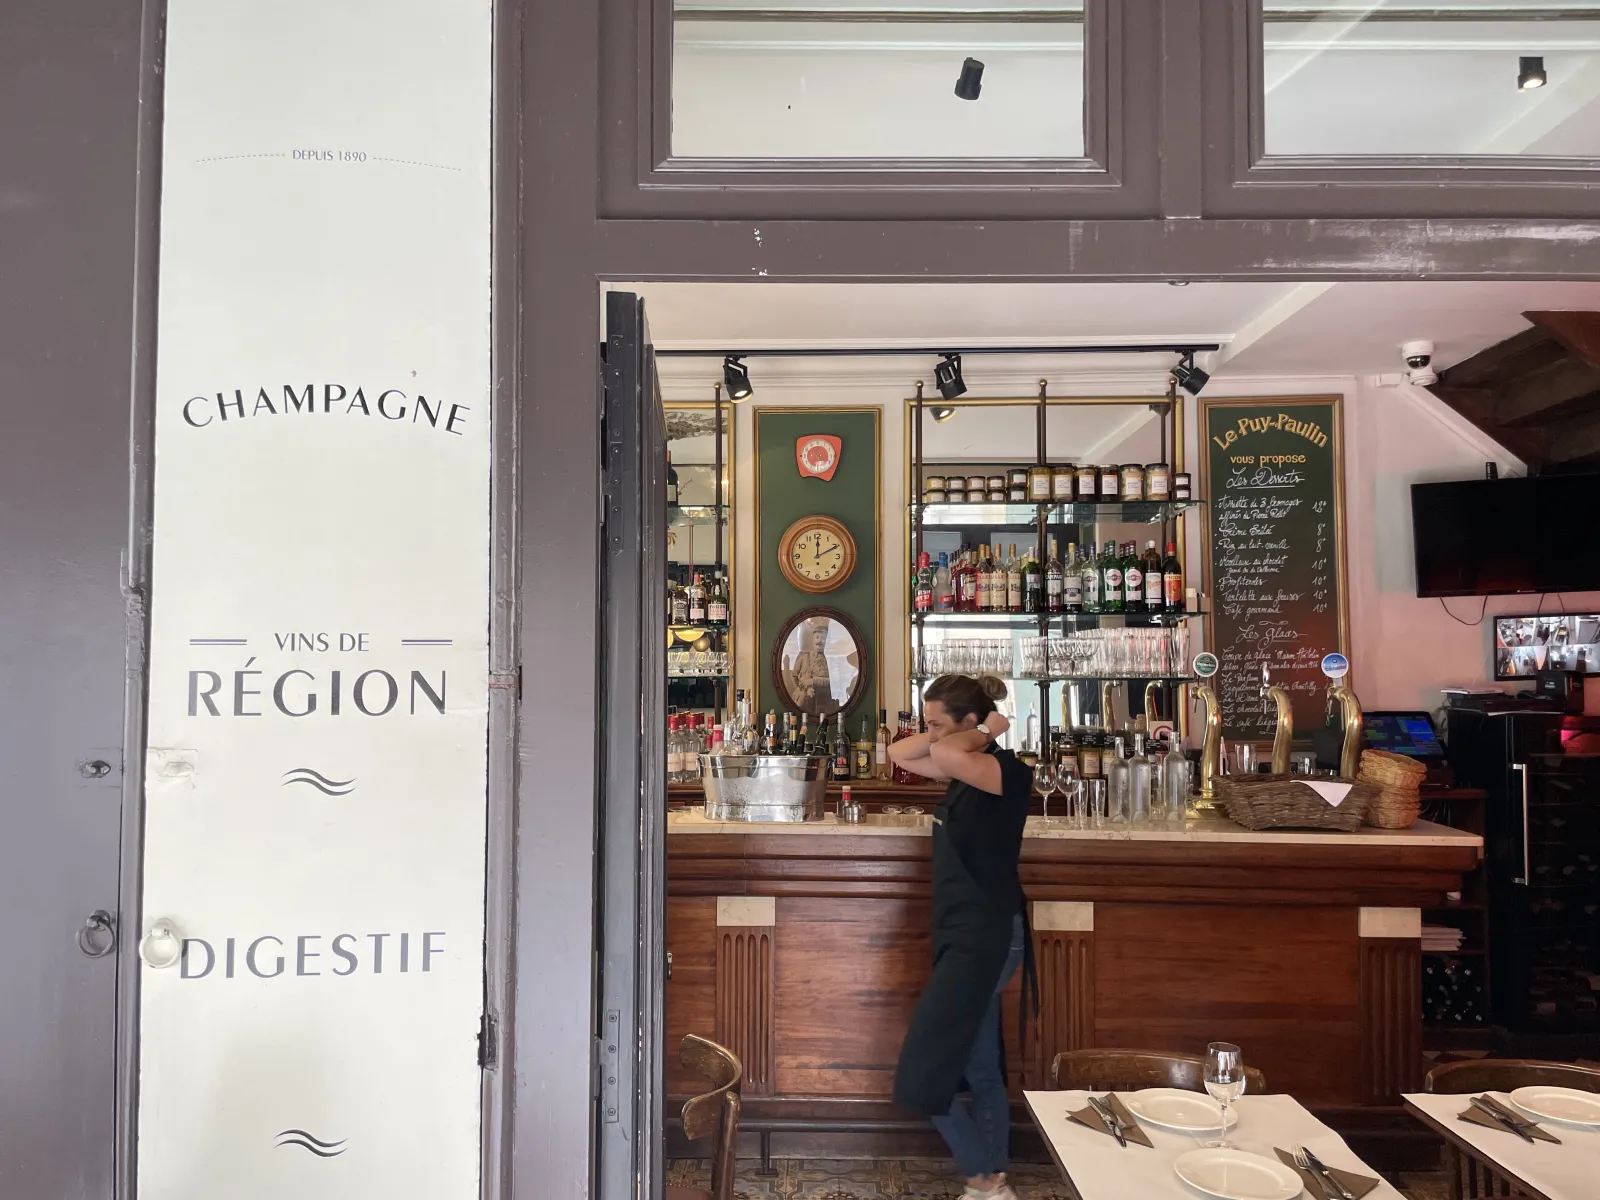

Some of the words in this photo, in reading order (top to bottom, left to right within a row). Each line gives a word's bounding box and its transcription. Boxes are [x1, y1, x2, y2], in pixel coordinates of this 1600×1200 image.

[292, 149, 334, 161] DEPUIS
[338, 150, 367, 162] 1890
[182, 383, 471, 436] CHAMPAGNE
[1213, 430, 1238, 451] Le
[1238, 413, 1328, 448] Puy-Paulin
[1230, 455, 1255, 464] vous
[1259, 454, 1306, 468] propose
[1226, 467, 1248, 488] Les
[1251, 466, 1305, 486] Desserts
[1260, 497, 1267, 508] 3
[275, 633, 329, 652] VINS
[339, 633, 370, 652] DE
[1235, 624, 1259, 643] Les
[188, 655, 446, 717] RÉGION
[180, 932, 447, 980] DIGESTIF
